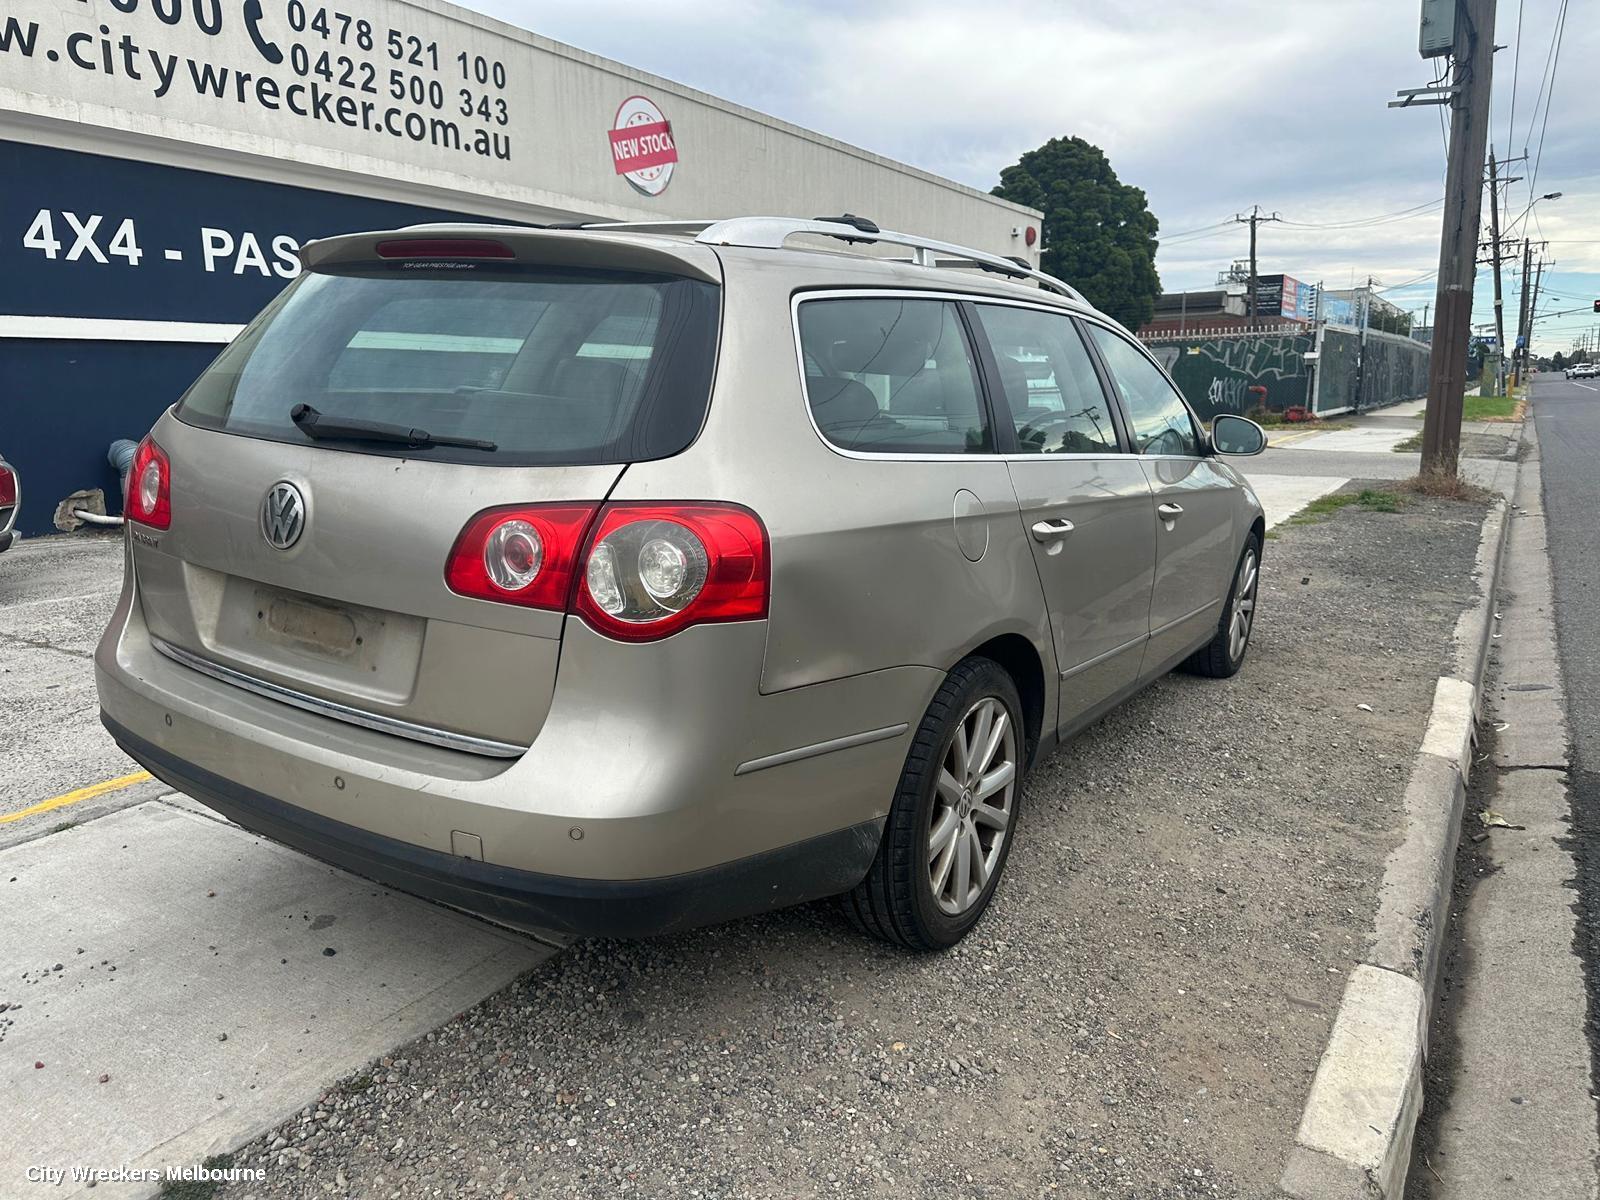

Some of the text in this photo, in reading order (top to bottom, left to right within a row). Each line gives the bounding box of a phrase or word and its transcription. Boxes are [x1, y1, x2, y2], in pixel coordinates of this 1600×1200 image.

[287, 0, 506, 90] 0478 521 100
[290, 43, 508, 126] 0422 500 343
[613, 132, 674, 160] NEW STOCK
[23, 208, 143, 266] 4X4
